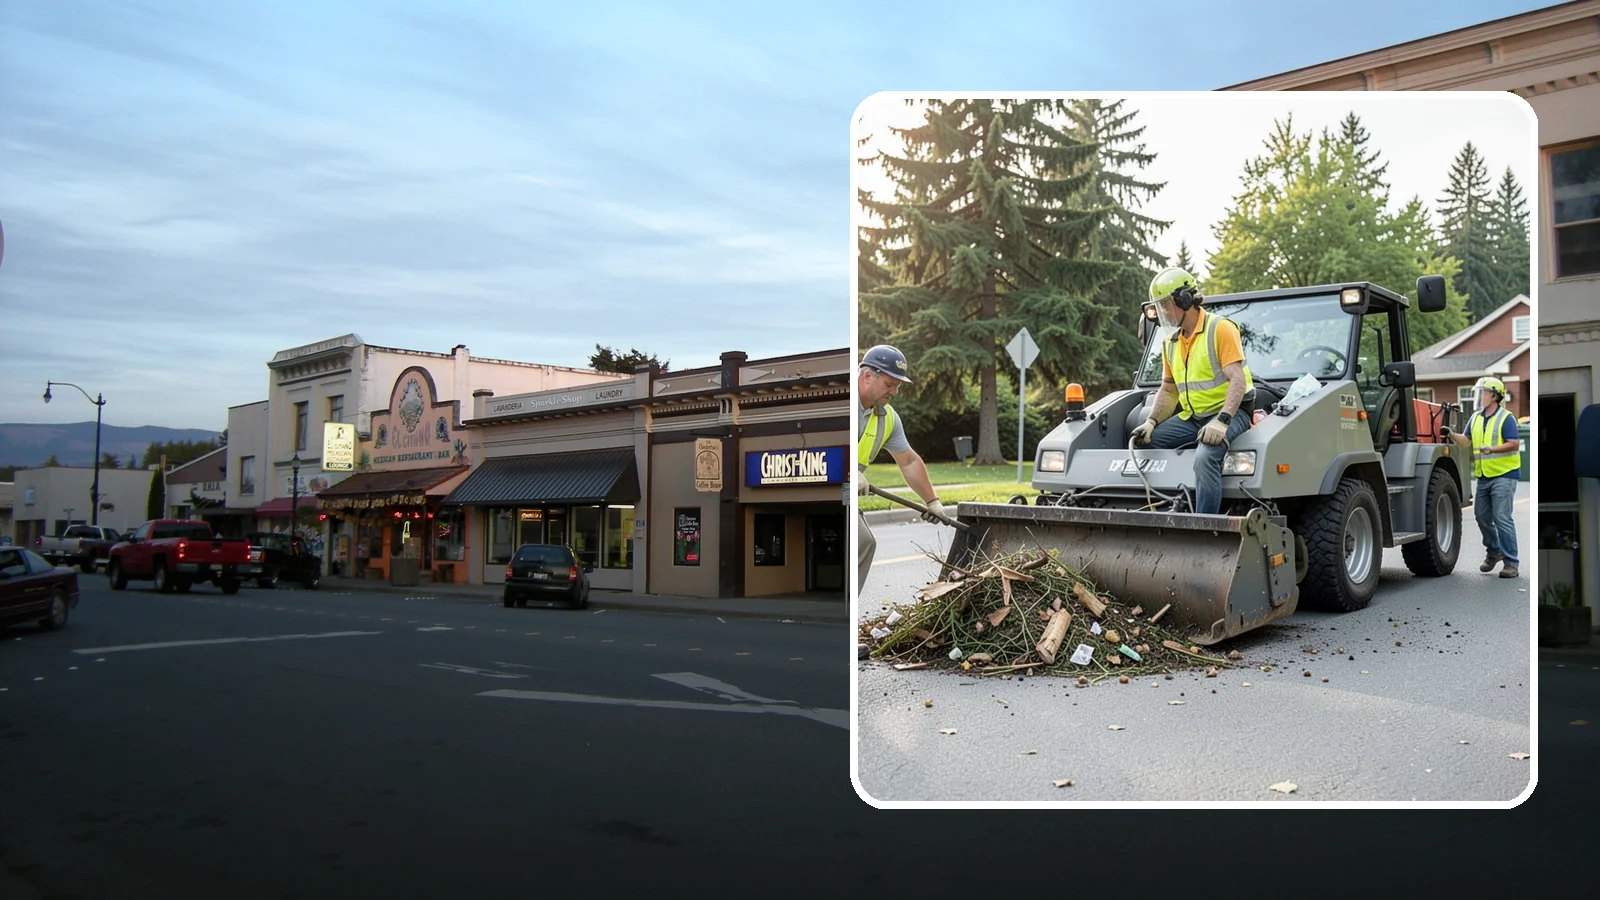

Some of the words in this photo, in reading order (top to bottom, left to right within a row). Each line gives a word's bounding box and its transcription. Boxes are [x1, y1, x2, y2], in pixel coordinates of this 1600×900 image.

[493, 402, 522, 412] LAVANDERIA
[561, 394, 582, 405] Shop
[595, 389, 623, 399] LAUNDRY
[373, 455, 396, 464] MEXICAN
[397, 452, 433, 462] RESTAURANT
[438, 450, 450, 459] BAR
[799, 450, 827, 476] KING
